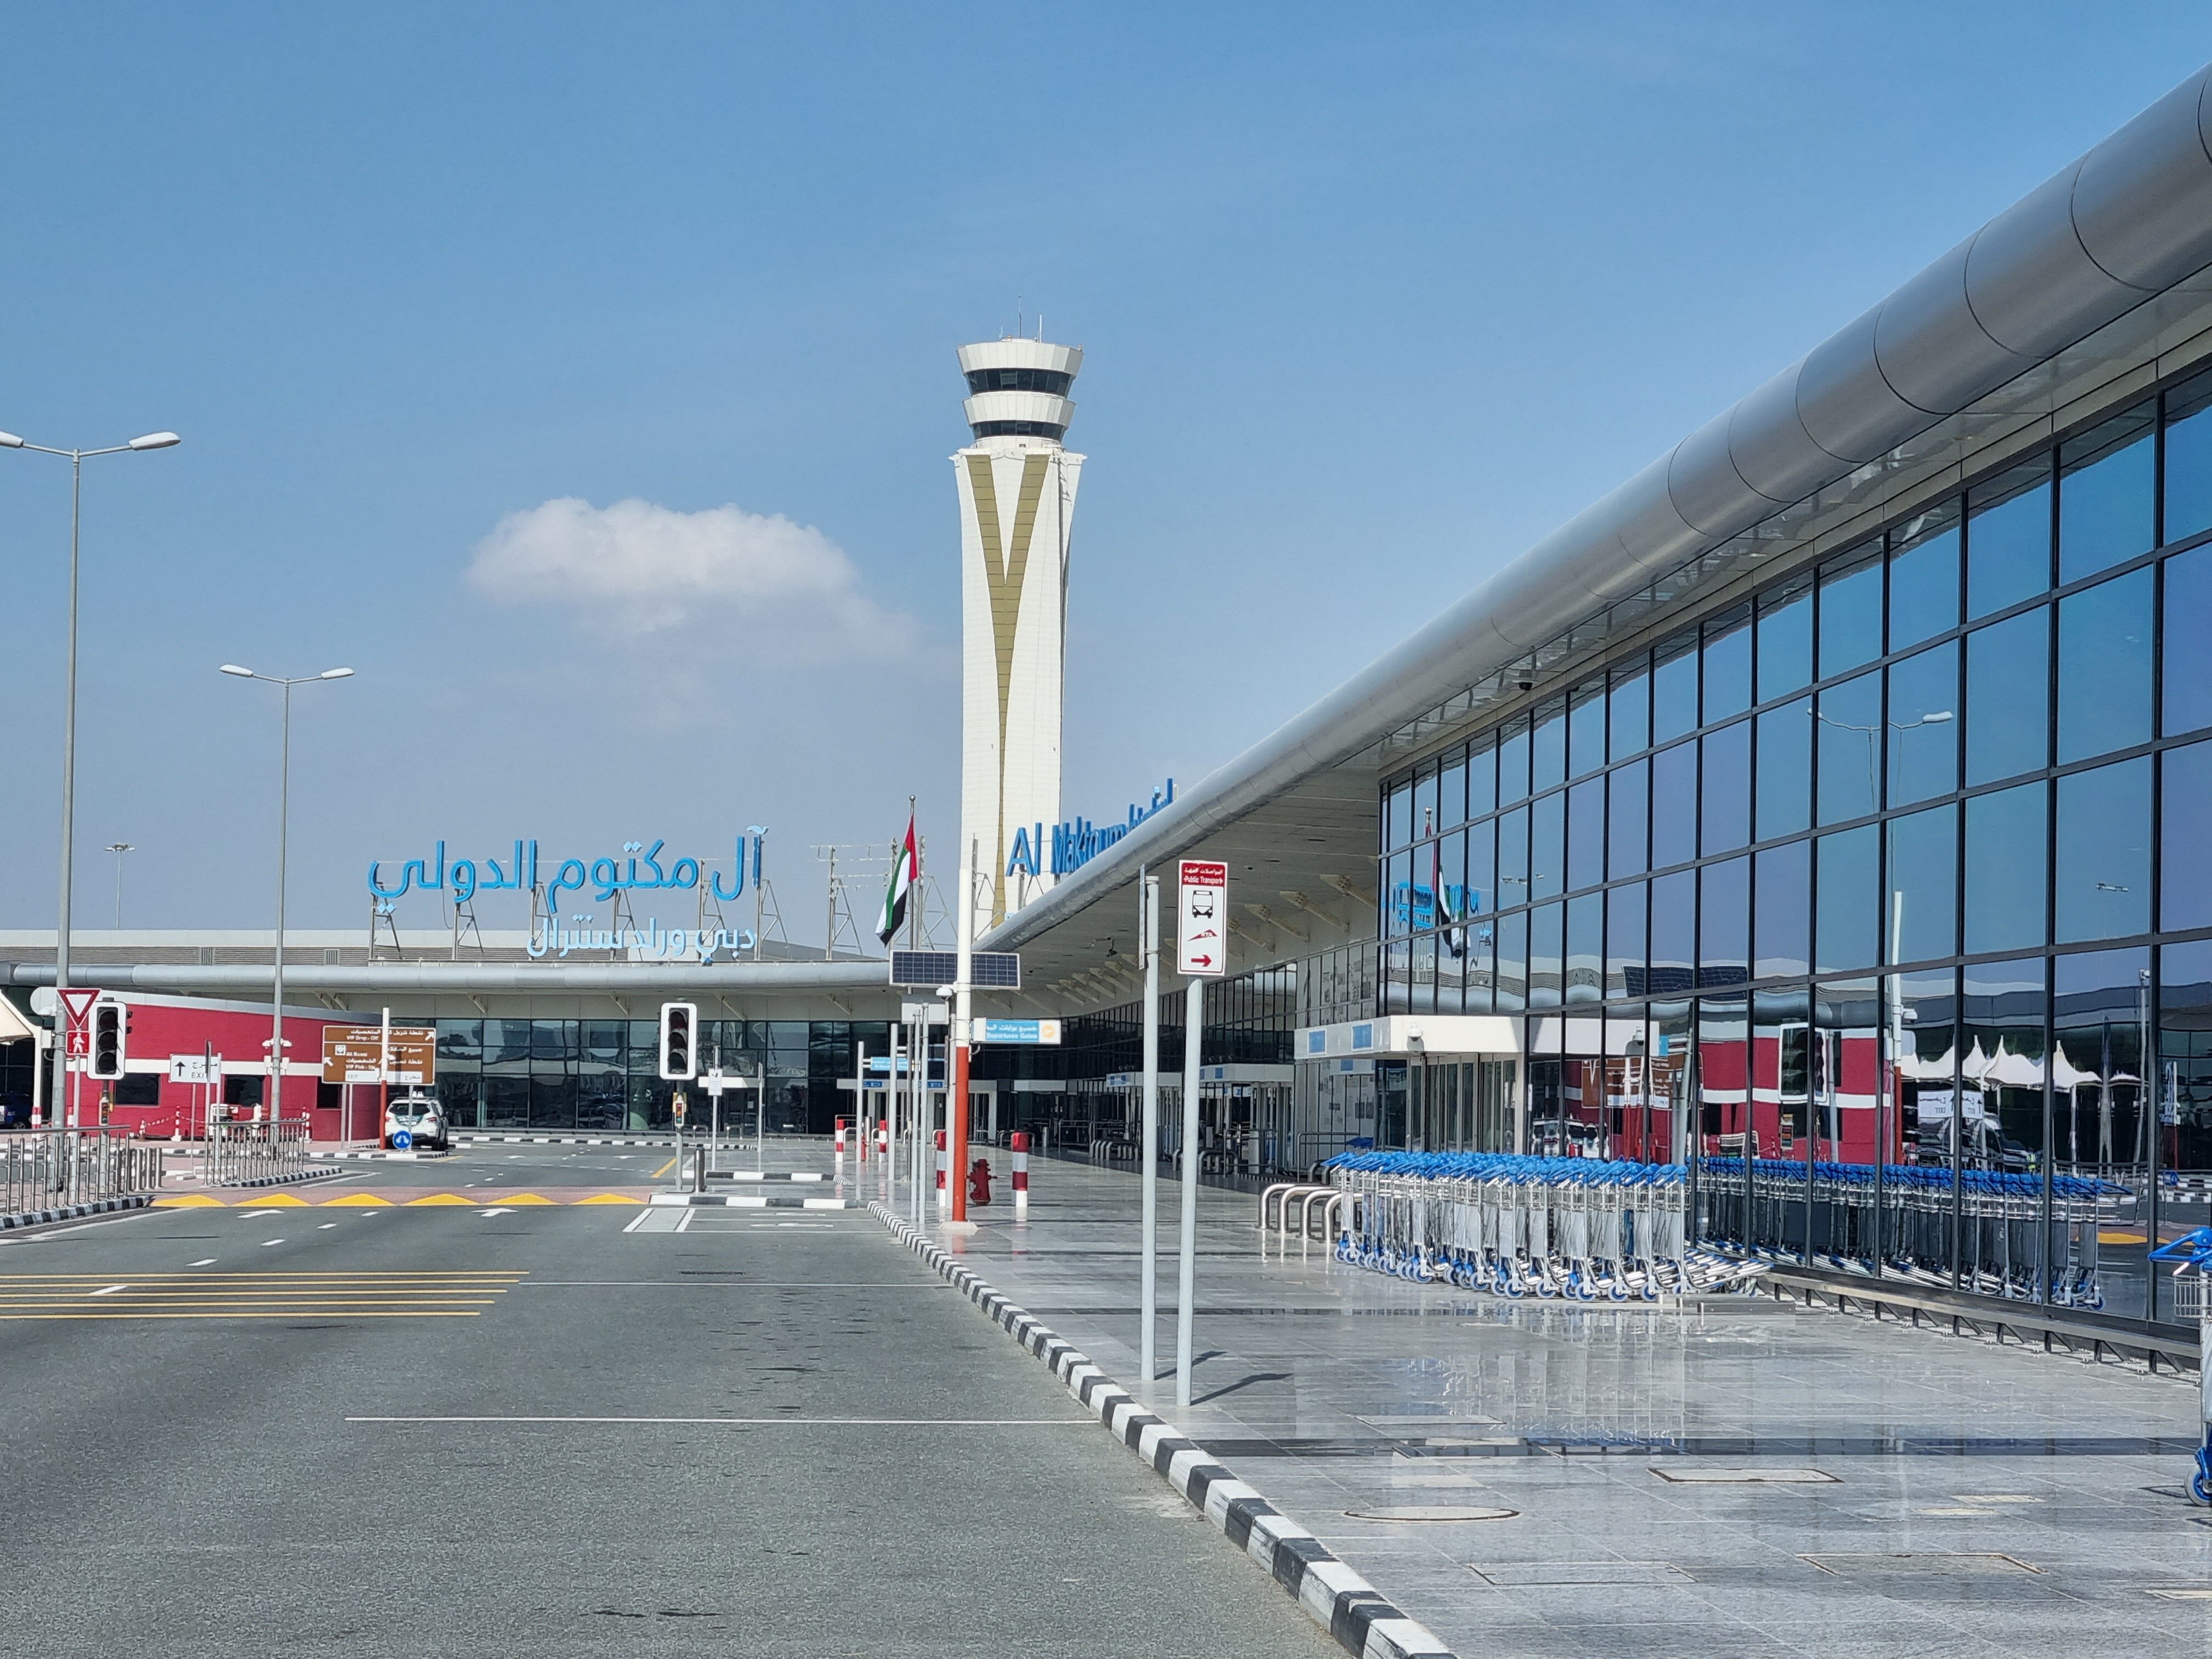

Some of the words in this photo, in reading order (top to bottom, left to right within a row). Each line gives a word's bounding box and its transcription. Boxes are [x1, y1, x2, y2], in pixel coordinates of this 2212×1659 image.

[368, 839, 538, 915] الدولي
[547, 839, 699, 913] مكتوم
[711, 825, 769, 901] آل
[1005, 822, 1042, 877] Al
[1183, 875, 1199, 883] Public
[1200, 876, 1223, 885] Transport
[527, 913, 624, 957] سنترال
[695, 928, 757, 964] دبي
